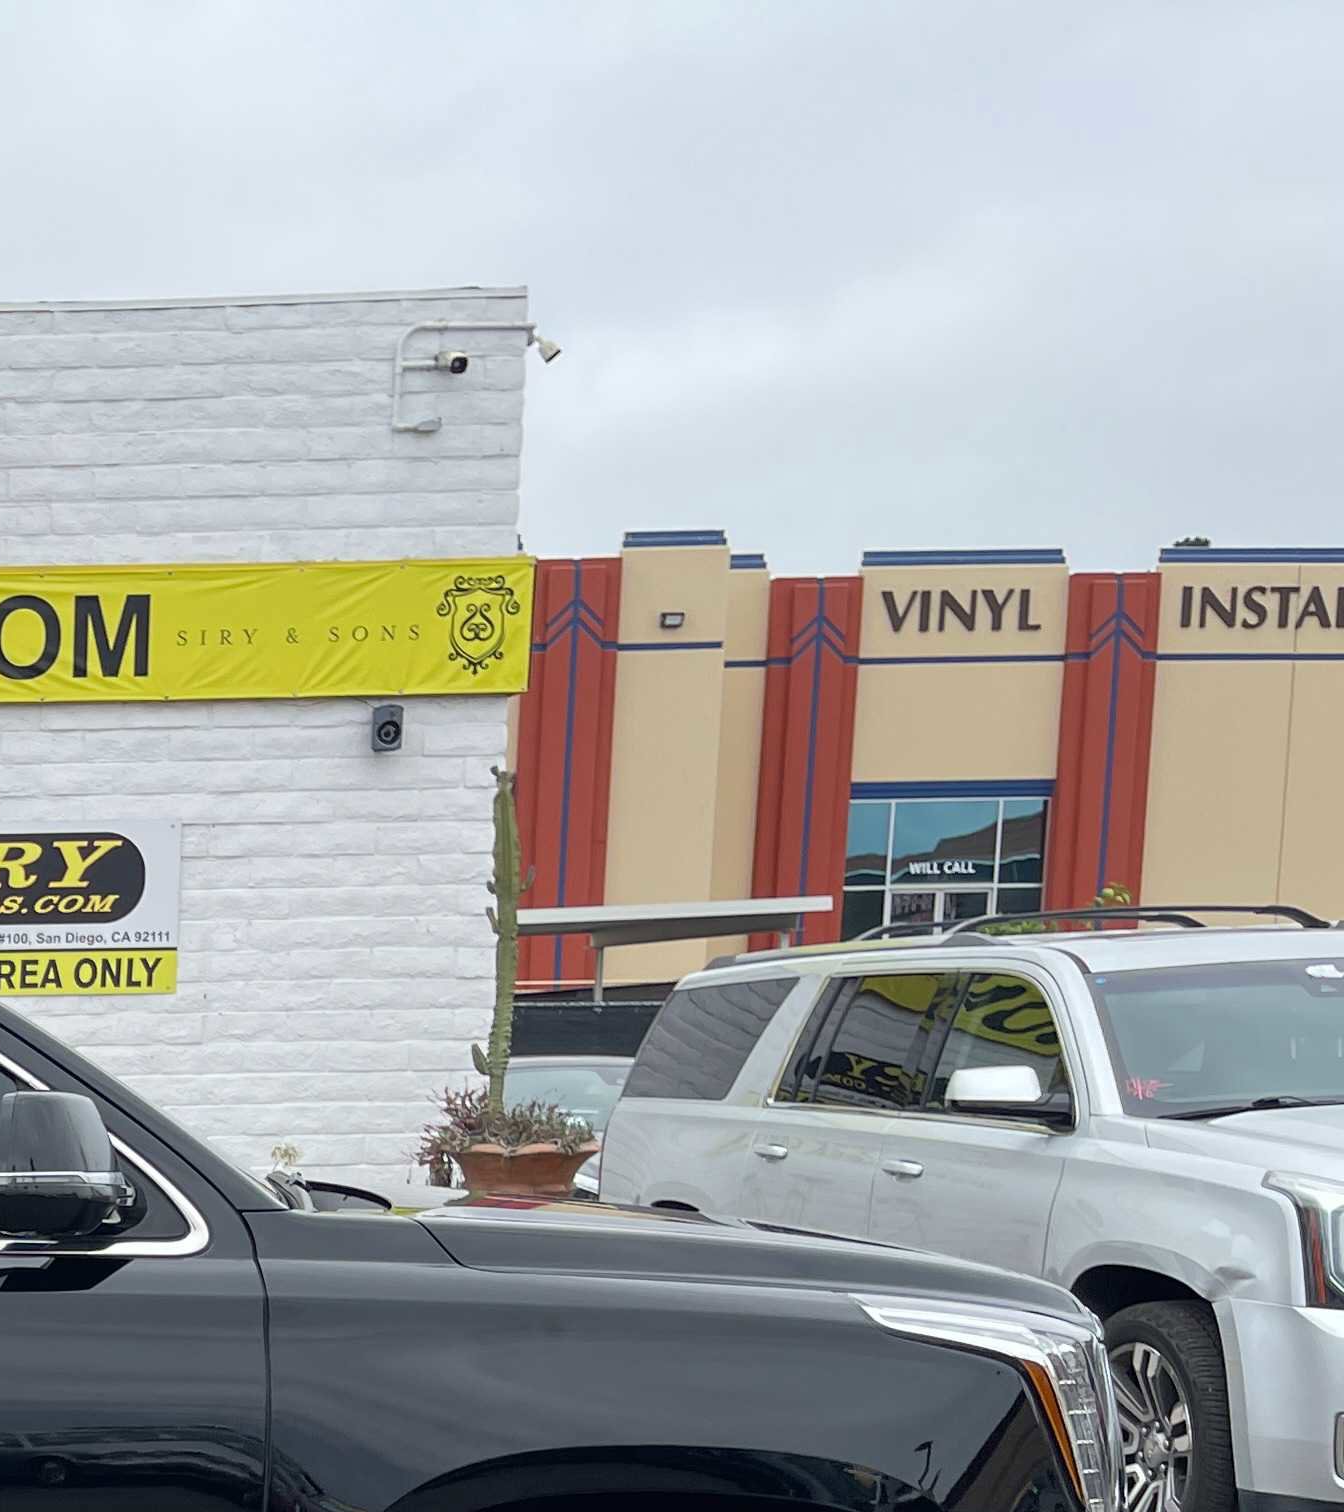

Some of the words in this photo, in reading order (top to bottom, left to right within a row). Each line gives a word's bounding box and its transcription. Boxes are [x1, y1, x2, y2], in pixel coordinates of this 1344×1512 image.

[881, 588, 1042, 633] VINYL
[176, 628, 259, 647] SIRY
[286, 628, 300, 644] &
[328, 624, 421, 643] SONS
[908, 861, 941, 875] WILL
[943, 860, 976, 874] CALL
[36, 931, 61, 944] San
[65, 931, 107, 946] Diego,
[111, 931, 131, 944] CA
[134, 930, 171, 943] 92111
[74, 957, 163, 989] ONLY
